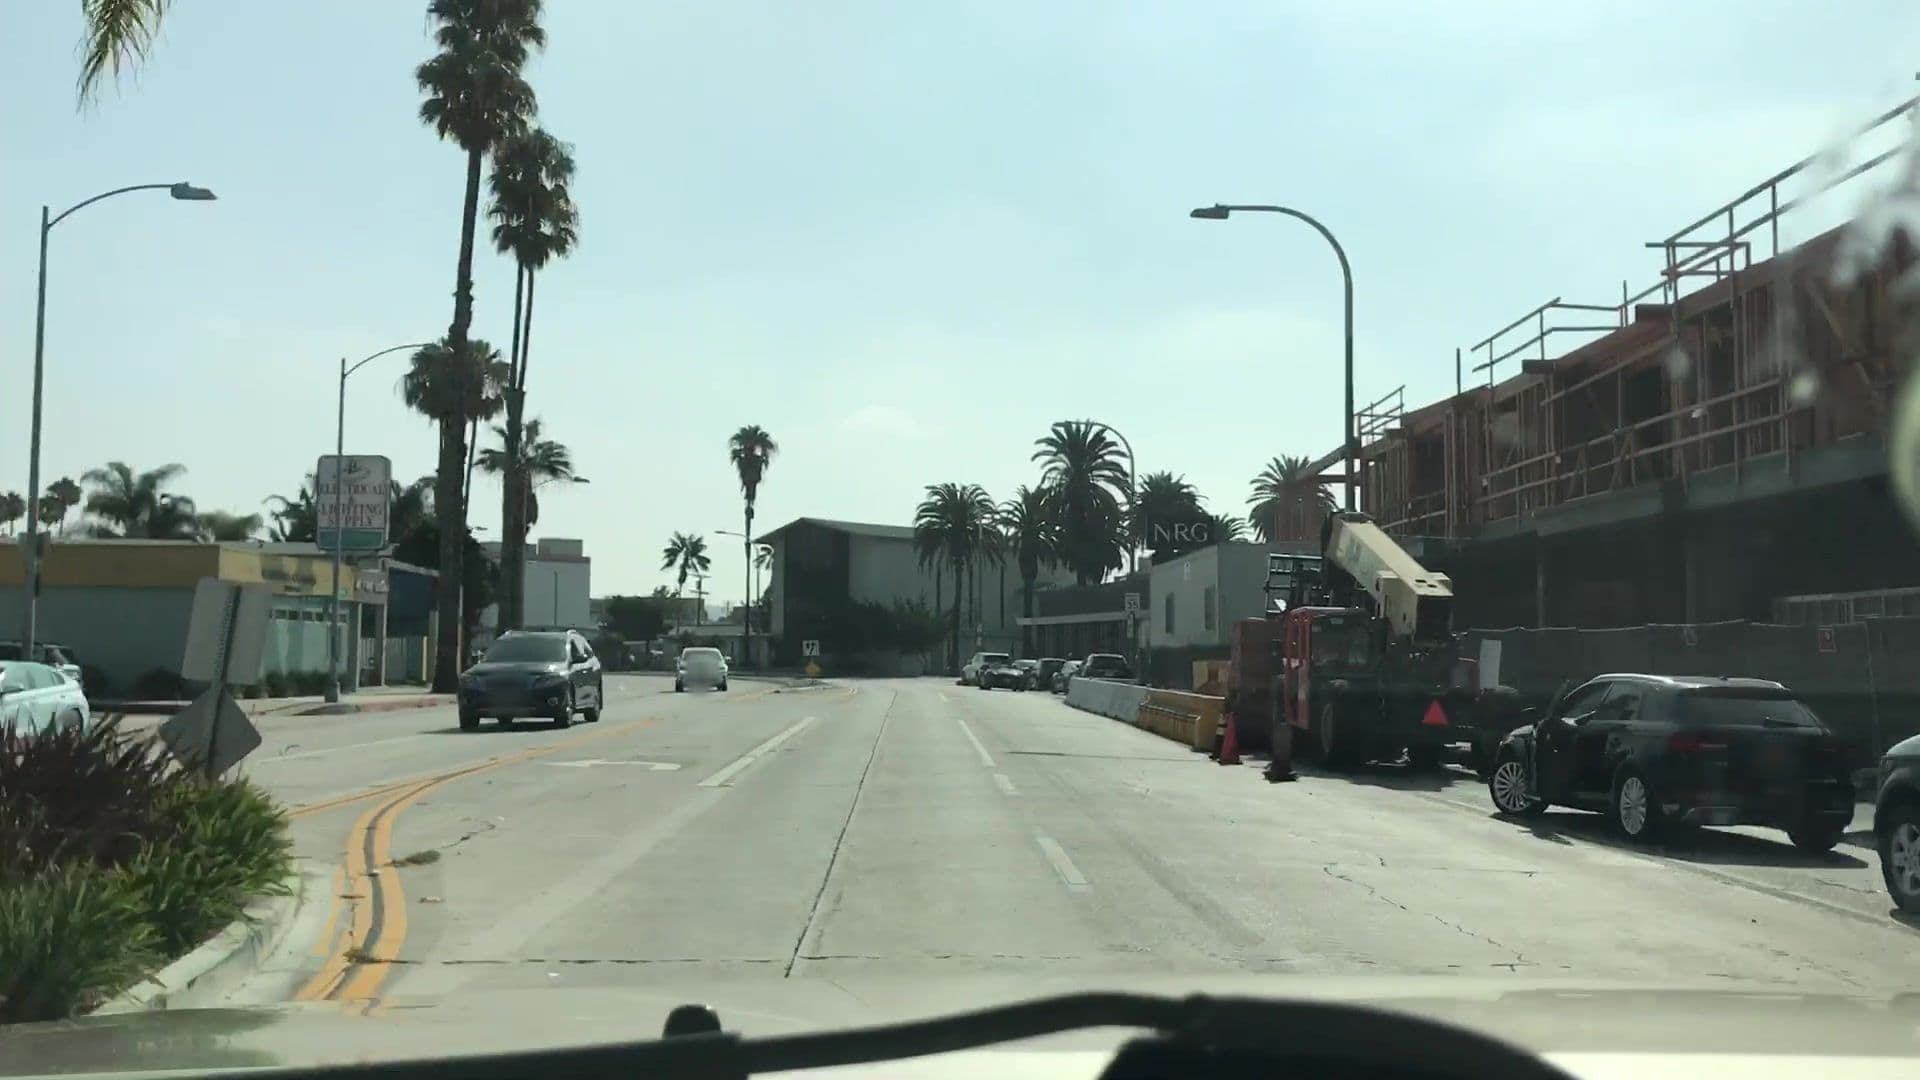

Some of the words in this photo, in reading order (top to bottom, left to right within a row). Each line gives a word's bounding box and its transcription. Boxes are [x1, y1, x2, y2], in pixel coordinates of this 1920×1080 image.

[319, 483, 384, 494] ELETRICAL
[328, 515, 373, 526] SPPLY
[1153, 522, 1208, 543] NRG
